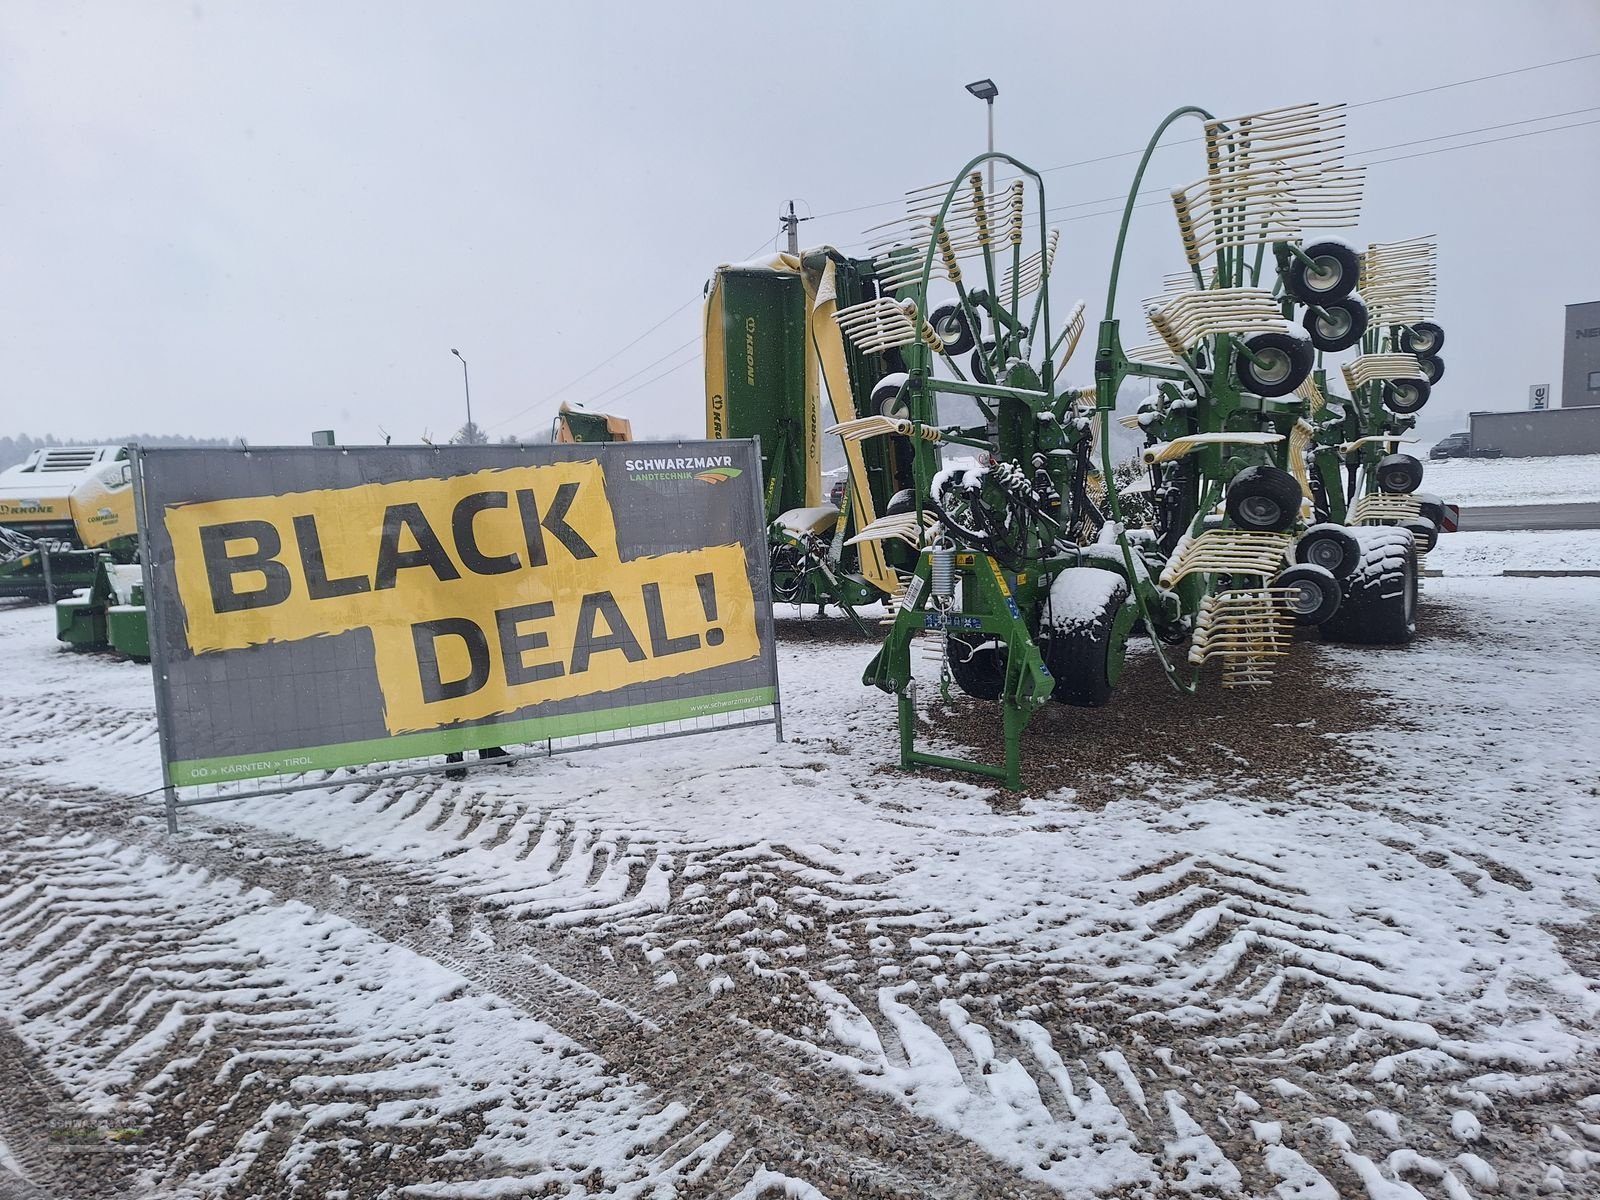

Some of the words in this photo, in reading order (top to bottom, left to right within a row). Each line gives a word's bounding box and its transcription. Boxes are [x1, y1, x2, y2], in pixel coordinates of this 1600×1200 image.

[1576, 327, 1600, 339] NE
[746, 333, 755, 387] KRONE
[625, 456, 732, 471] SCHWARZMAYR
[629, 472, 693, 482] LANDTECHNIK
[12, 505, 54, 514] KRONE
[199, 482, 597, 614] BLACK
[410, 573, 724, 704] DEAL!
[690, 695, 762, 711] www.schwarzmayr.at
[283, 756, 313, 767] TIROL
